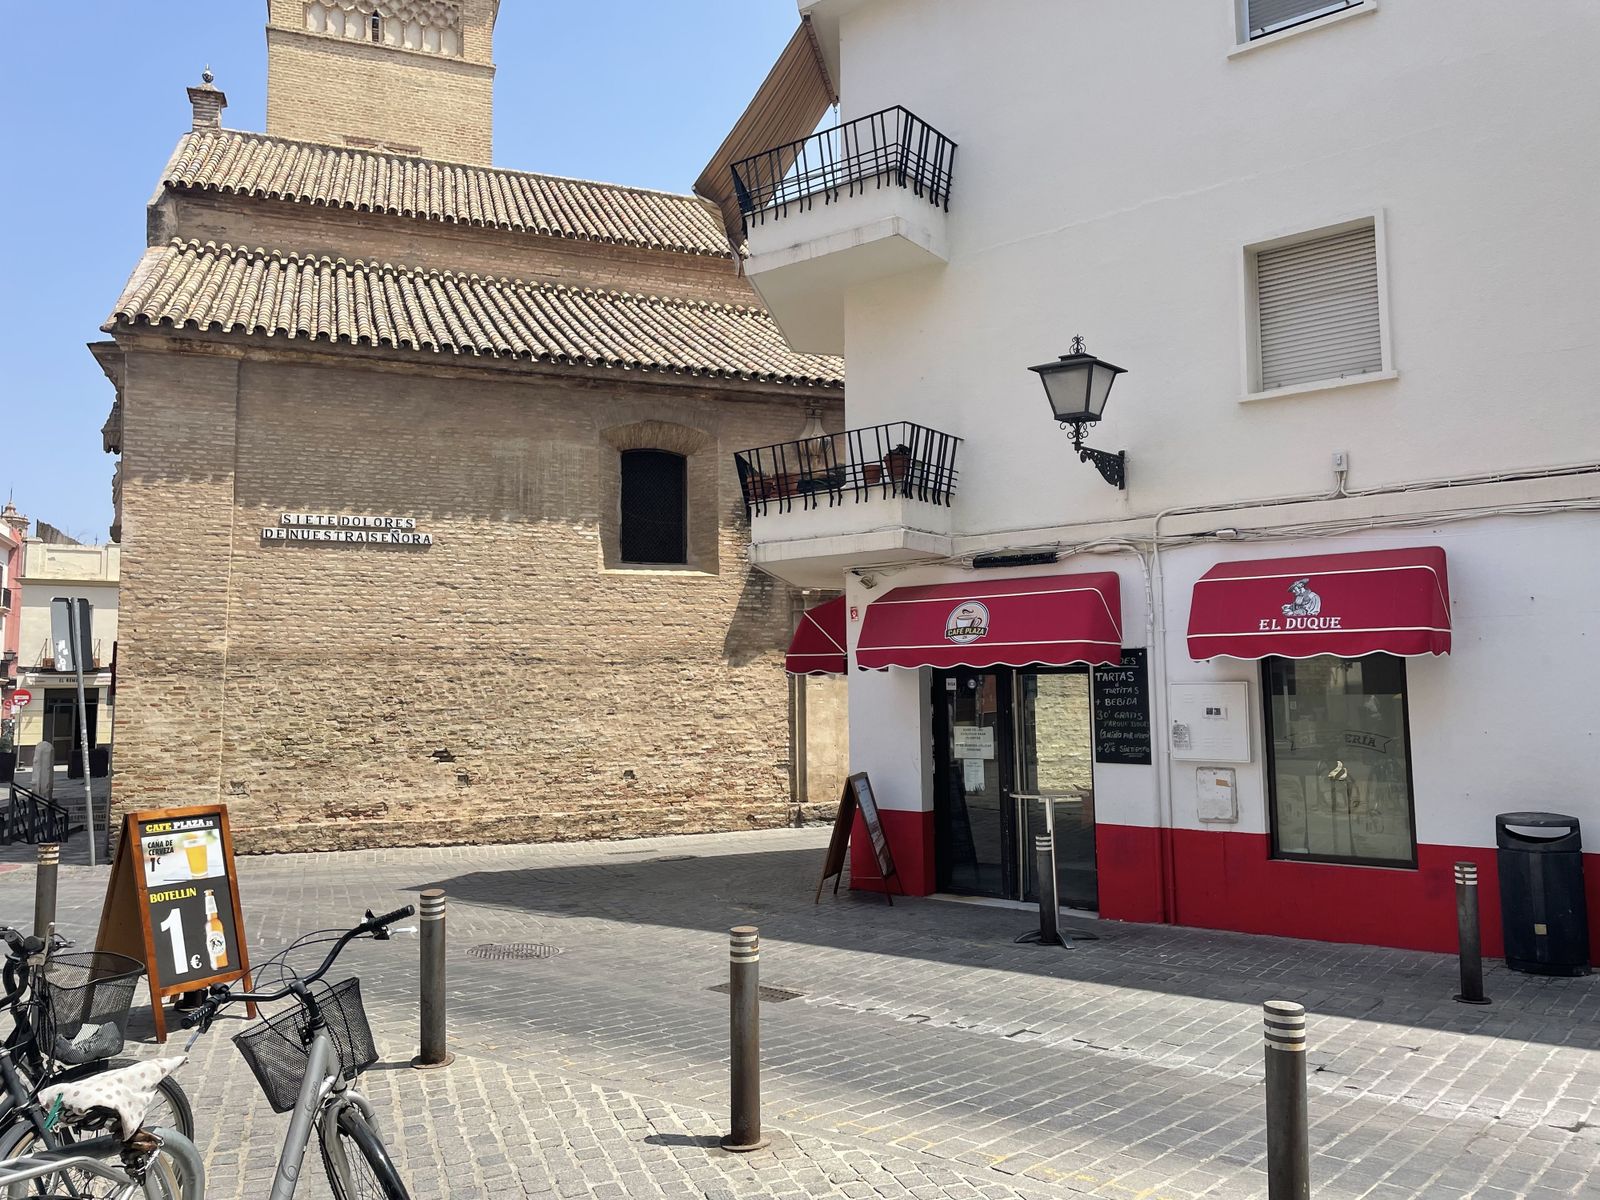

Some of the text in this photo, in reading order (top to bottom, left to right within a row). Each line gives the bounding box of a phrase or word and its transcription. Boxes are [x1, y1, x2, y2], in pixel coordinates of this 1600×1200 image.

[283, 514, 413, 528] SIETE DOLORES
[264, 528, 431, 544] DE NUESTRA SEÑORA
[1259, 617, 1342, 630] EL DUQUE
[964, 627, 984, 635] PLAZA
[1095, 671, 1135, 682] TARTAS
[173, 819, 205, 830] PLAZA
[147, 839, 173, 849] CAÑA DE
[148, 846, 175, 856] CERVEZA
[149, 887, 197, 903] BOTELLIN
